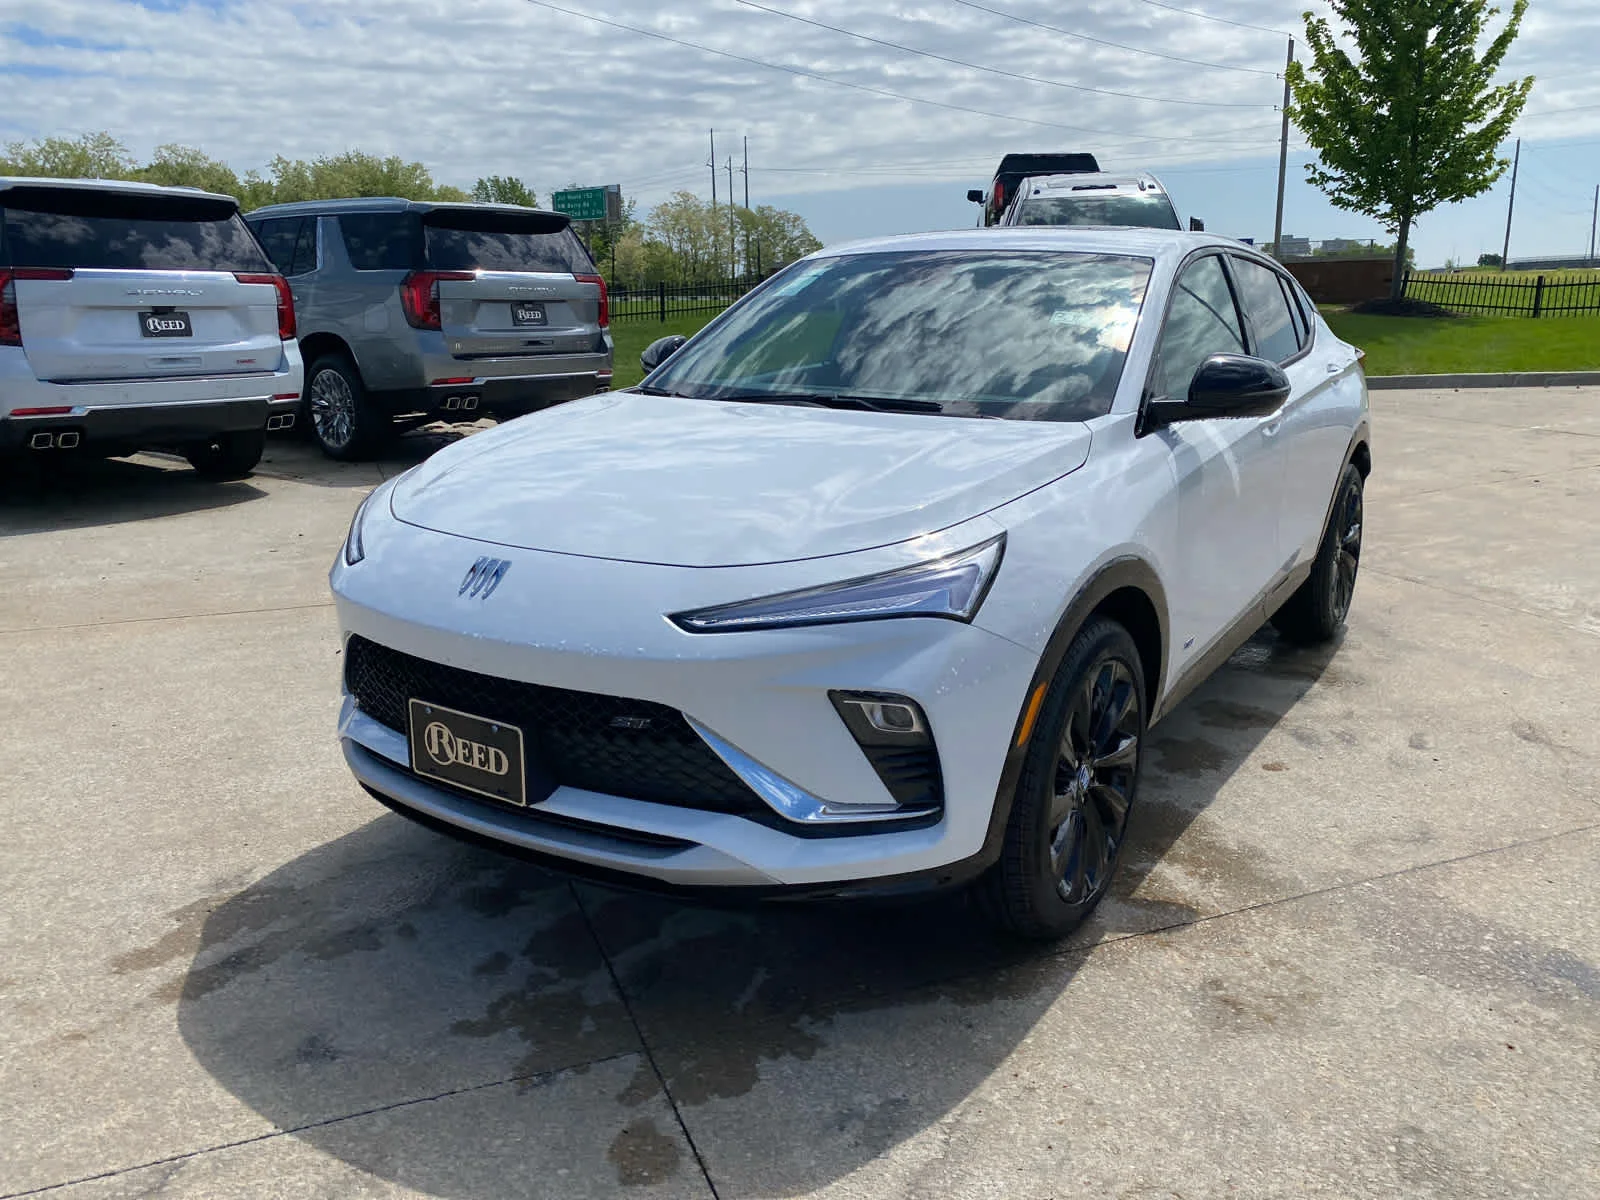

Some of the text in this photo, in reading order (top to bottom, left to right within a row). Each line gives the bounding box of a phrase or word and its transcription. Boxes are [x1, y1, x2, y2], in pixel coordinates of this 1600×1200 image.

[516, 309, 542, 320] REED
[146, 317, 186, 333] REED
[424, 721, 509, 776] REED
